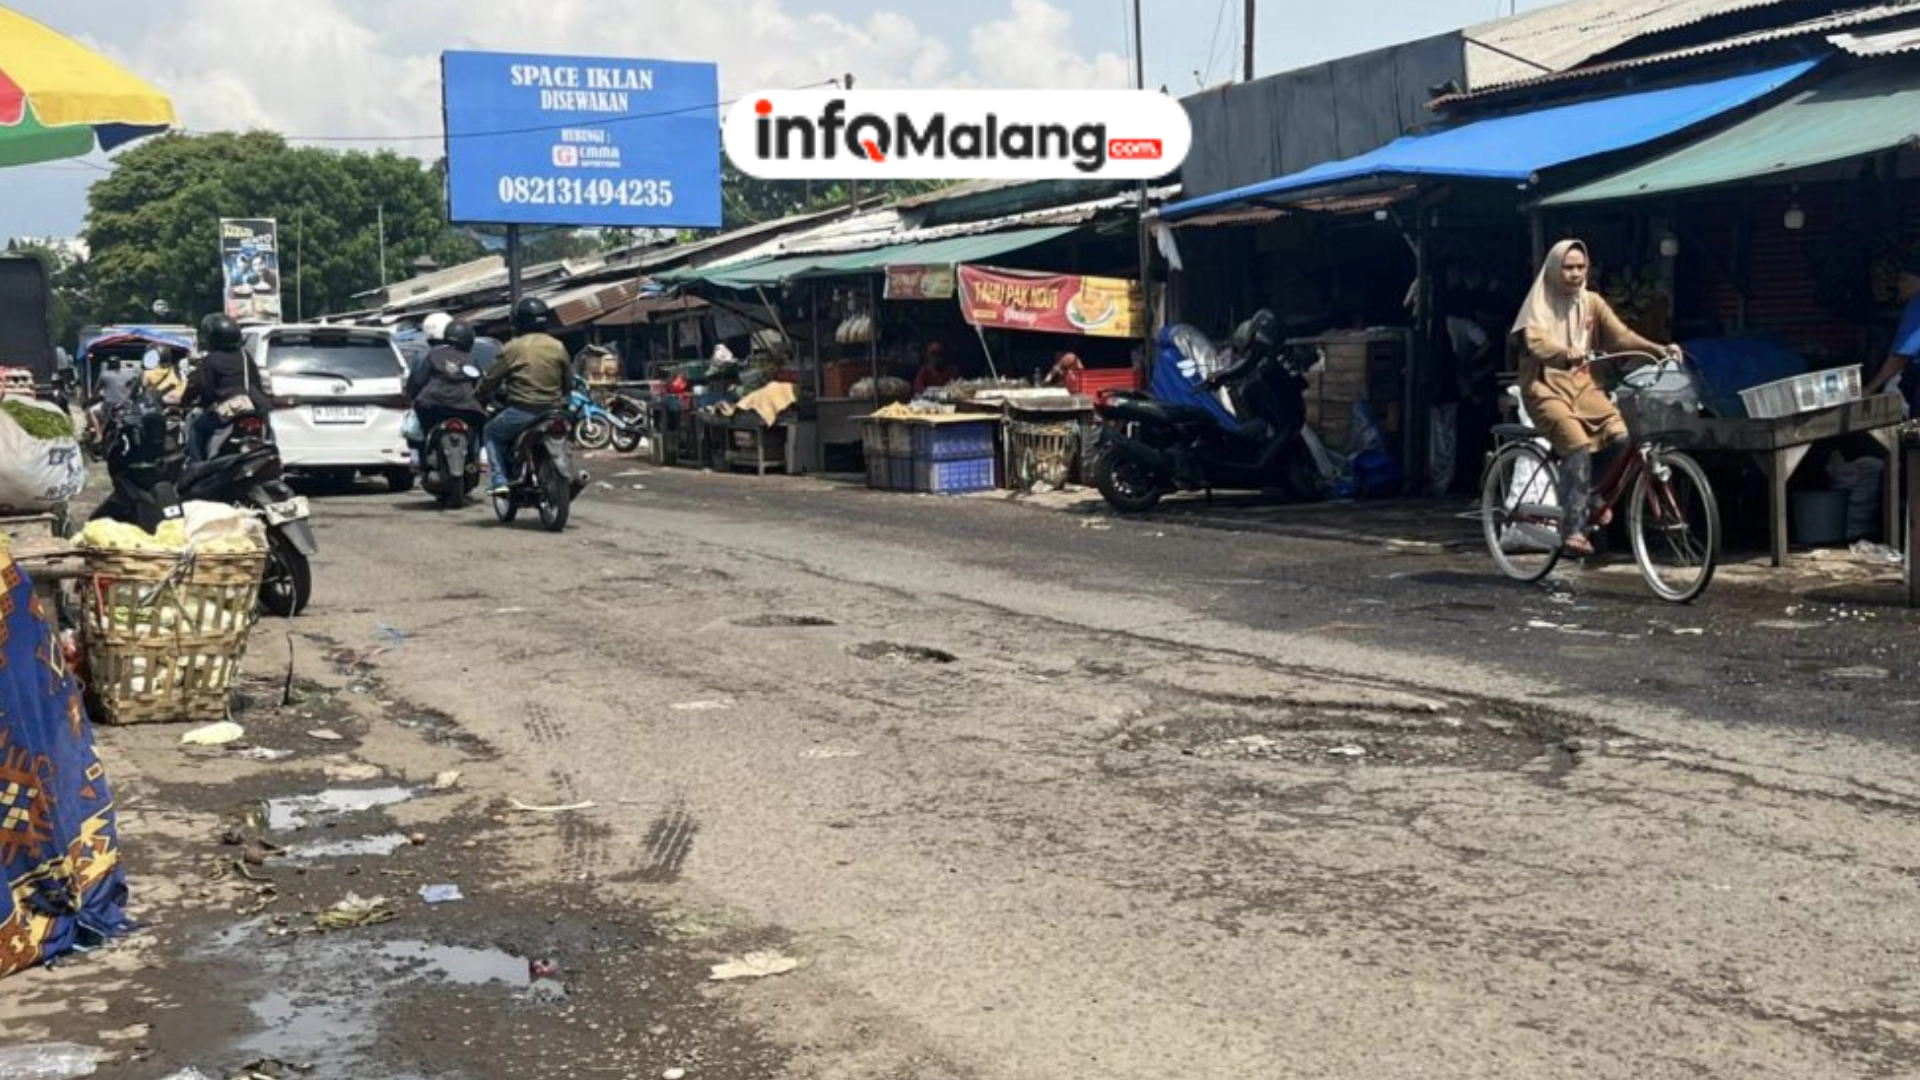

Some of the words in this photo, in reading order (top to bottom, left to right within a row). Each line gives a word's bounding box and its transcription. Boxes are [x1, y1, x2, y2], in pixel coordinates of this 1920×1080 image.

[510, 64, 580, 88] SPACE
[586, 68, 653, 90] IKLAN
[541, 91, 628, 112] DISEWAKAN
[499, 176, 673, 207] 082131494235
